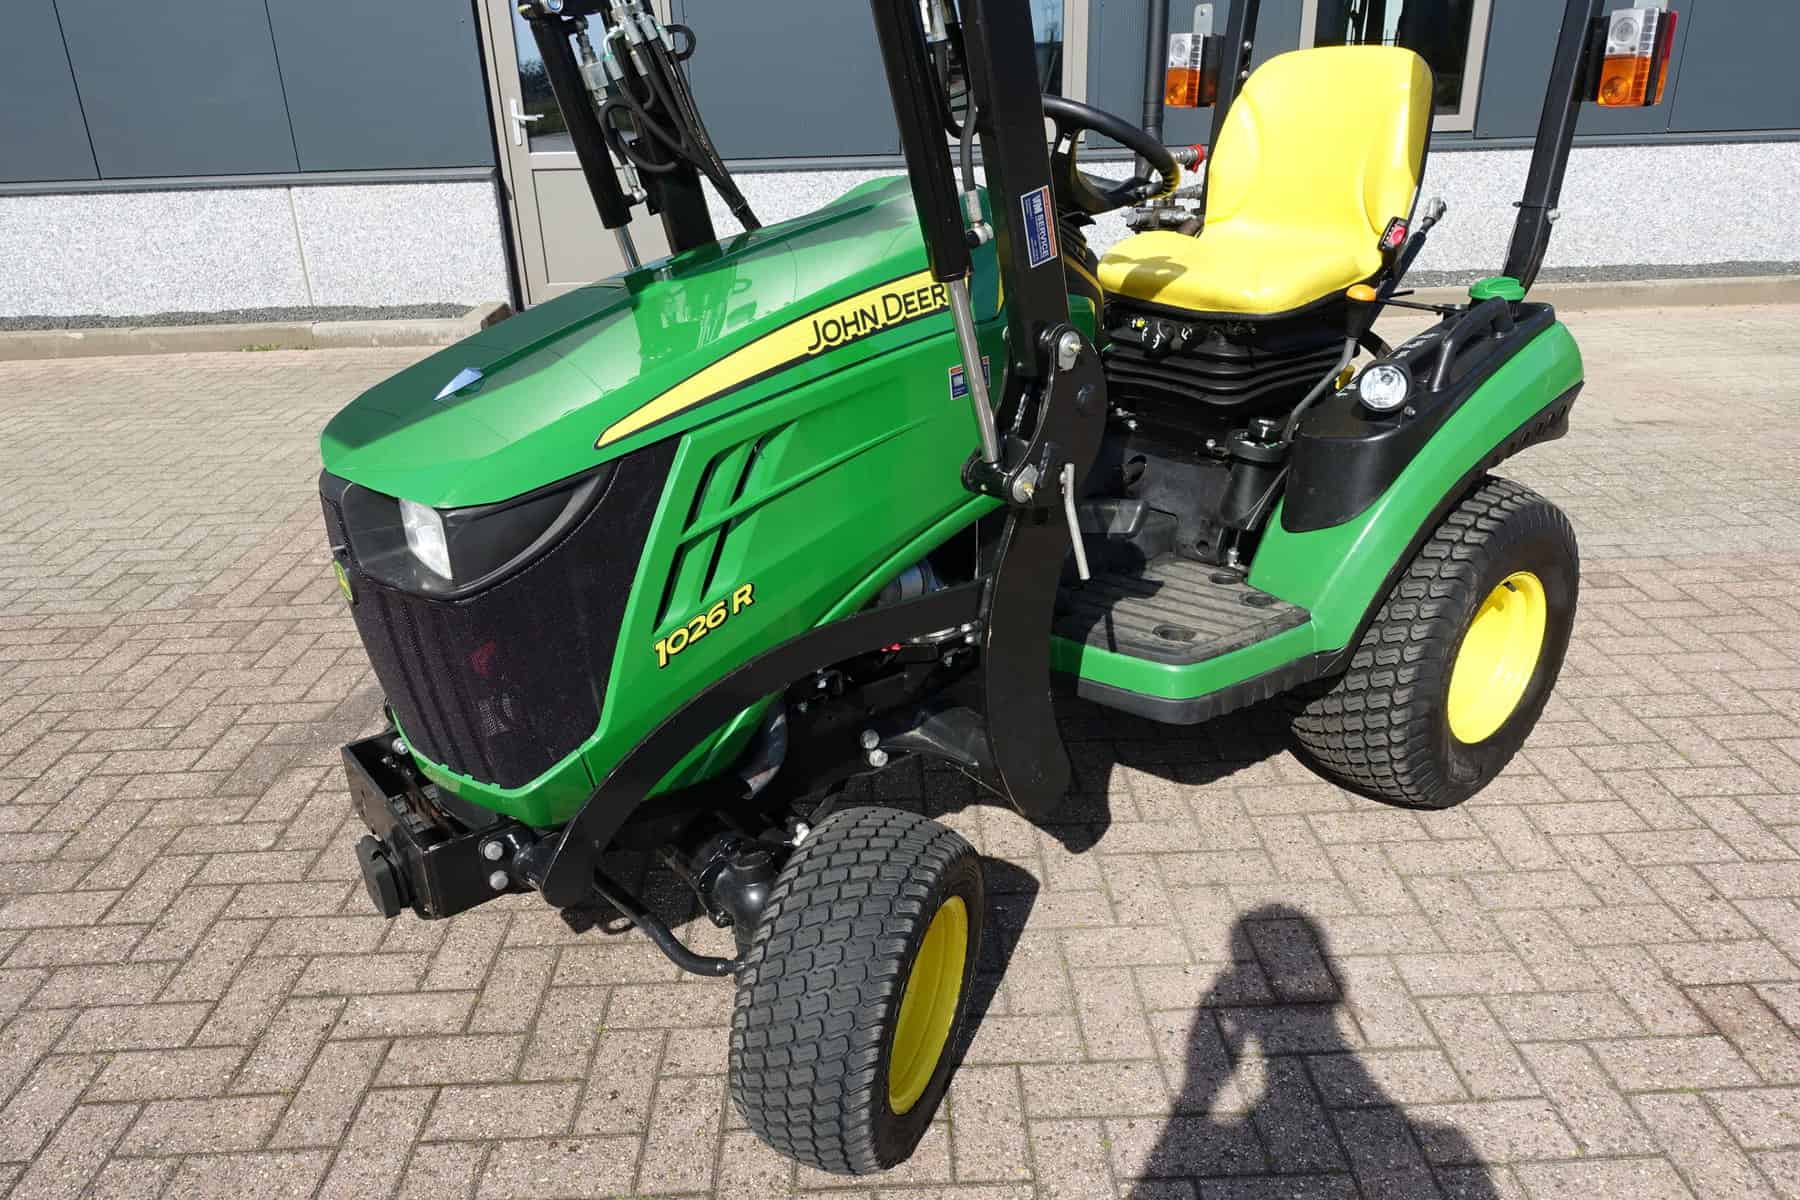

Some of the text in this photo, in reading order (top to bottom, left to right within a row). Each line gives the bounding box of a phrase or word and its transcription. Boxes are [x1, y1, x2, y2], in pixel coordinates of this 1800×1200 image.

[1036, 214, 1050, 257] SERVICE
[808, 284, 947, 351] JOHN DEER
[655, 584, 753, 668] 1026 R
